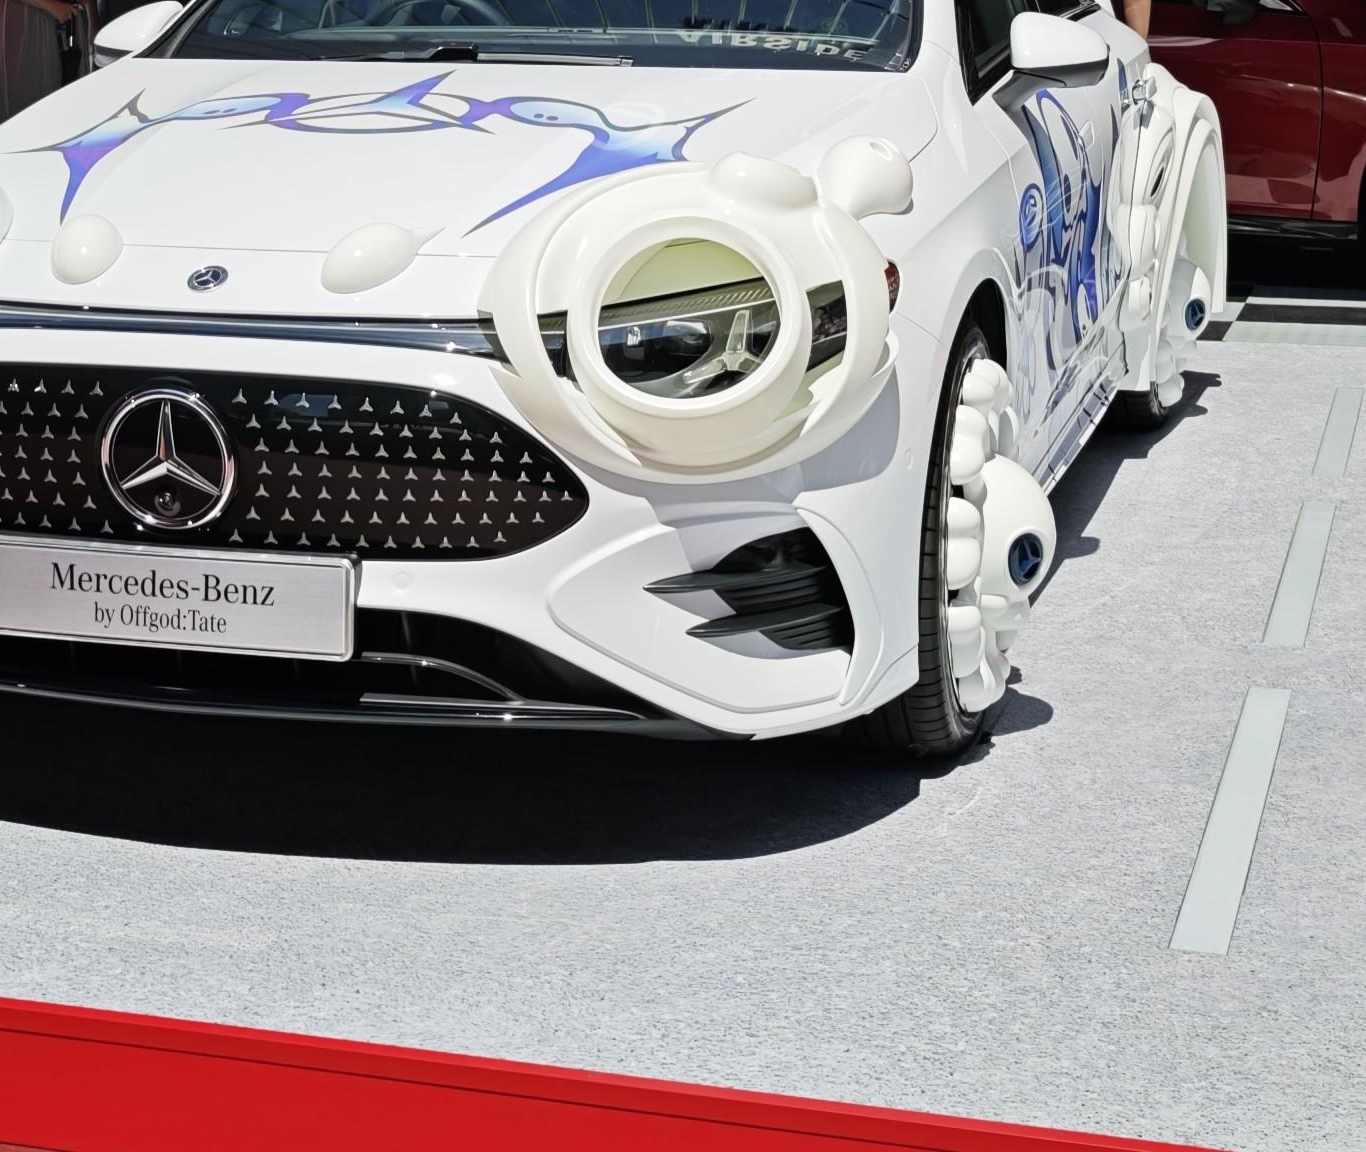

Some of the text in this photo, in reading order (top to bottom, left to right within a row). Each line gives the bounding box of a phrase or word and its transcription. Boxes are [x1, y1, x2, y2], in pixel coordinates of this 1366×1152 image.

[50, 561, 275, 608] Mercedes-Benz
[93, 601, 227, 635] by Offgod:Tate
